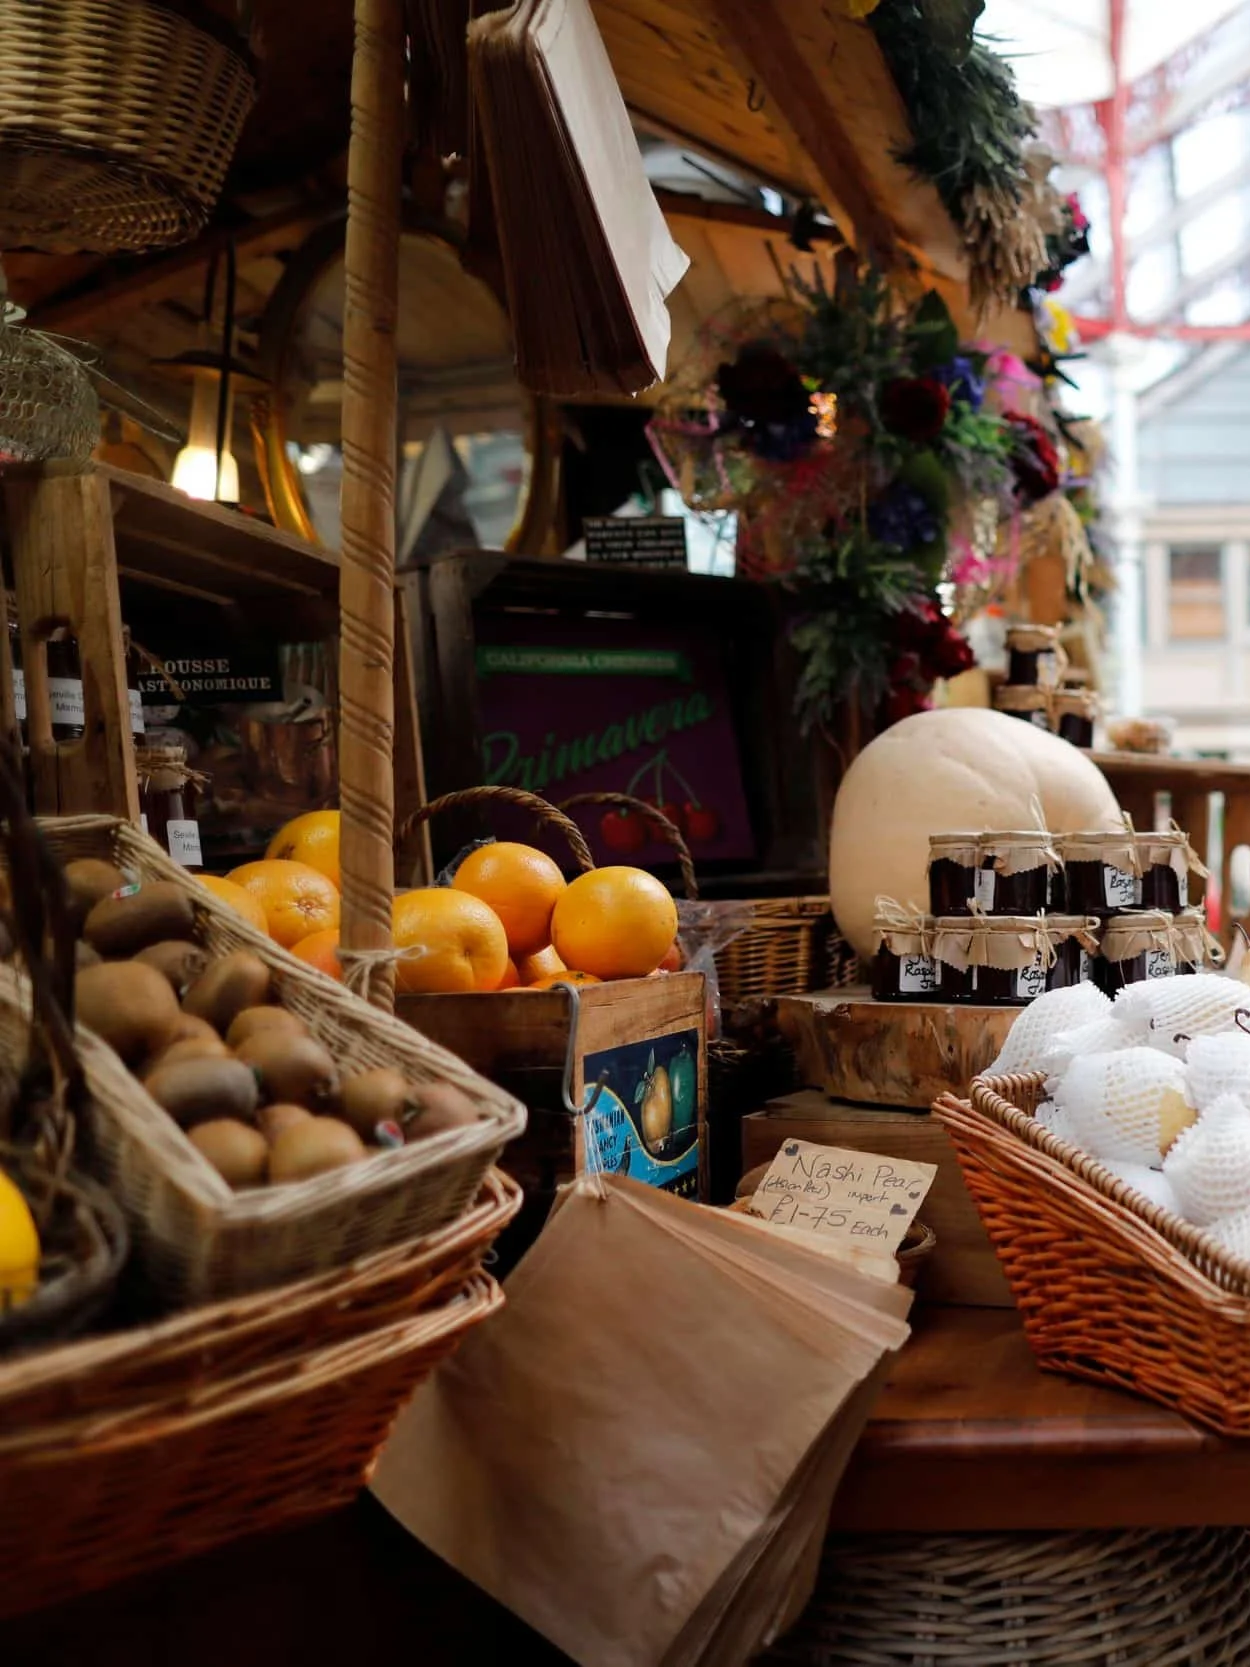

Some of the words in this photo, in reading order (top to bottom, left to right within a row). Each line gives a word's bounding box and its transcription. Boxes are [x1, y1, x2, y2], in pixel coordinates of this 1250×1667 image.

[792, 1154, 863, 1183] Nashi
[873, 1165, 923, 1193] Pear
[850, 1221, 889, 1240] Each
